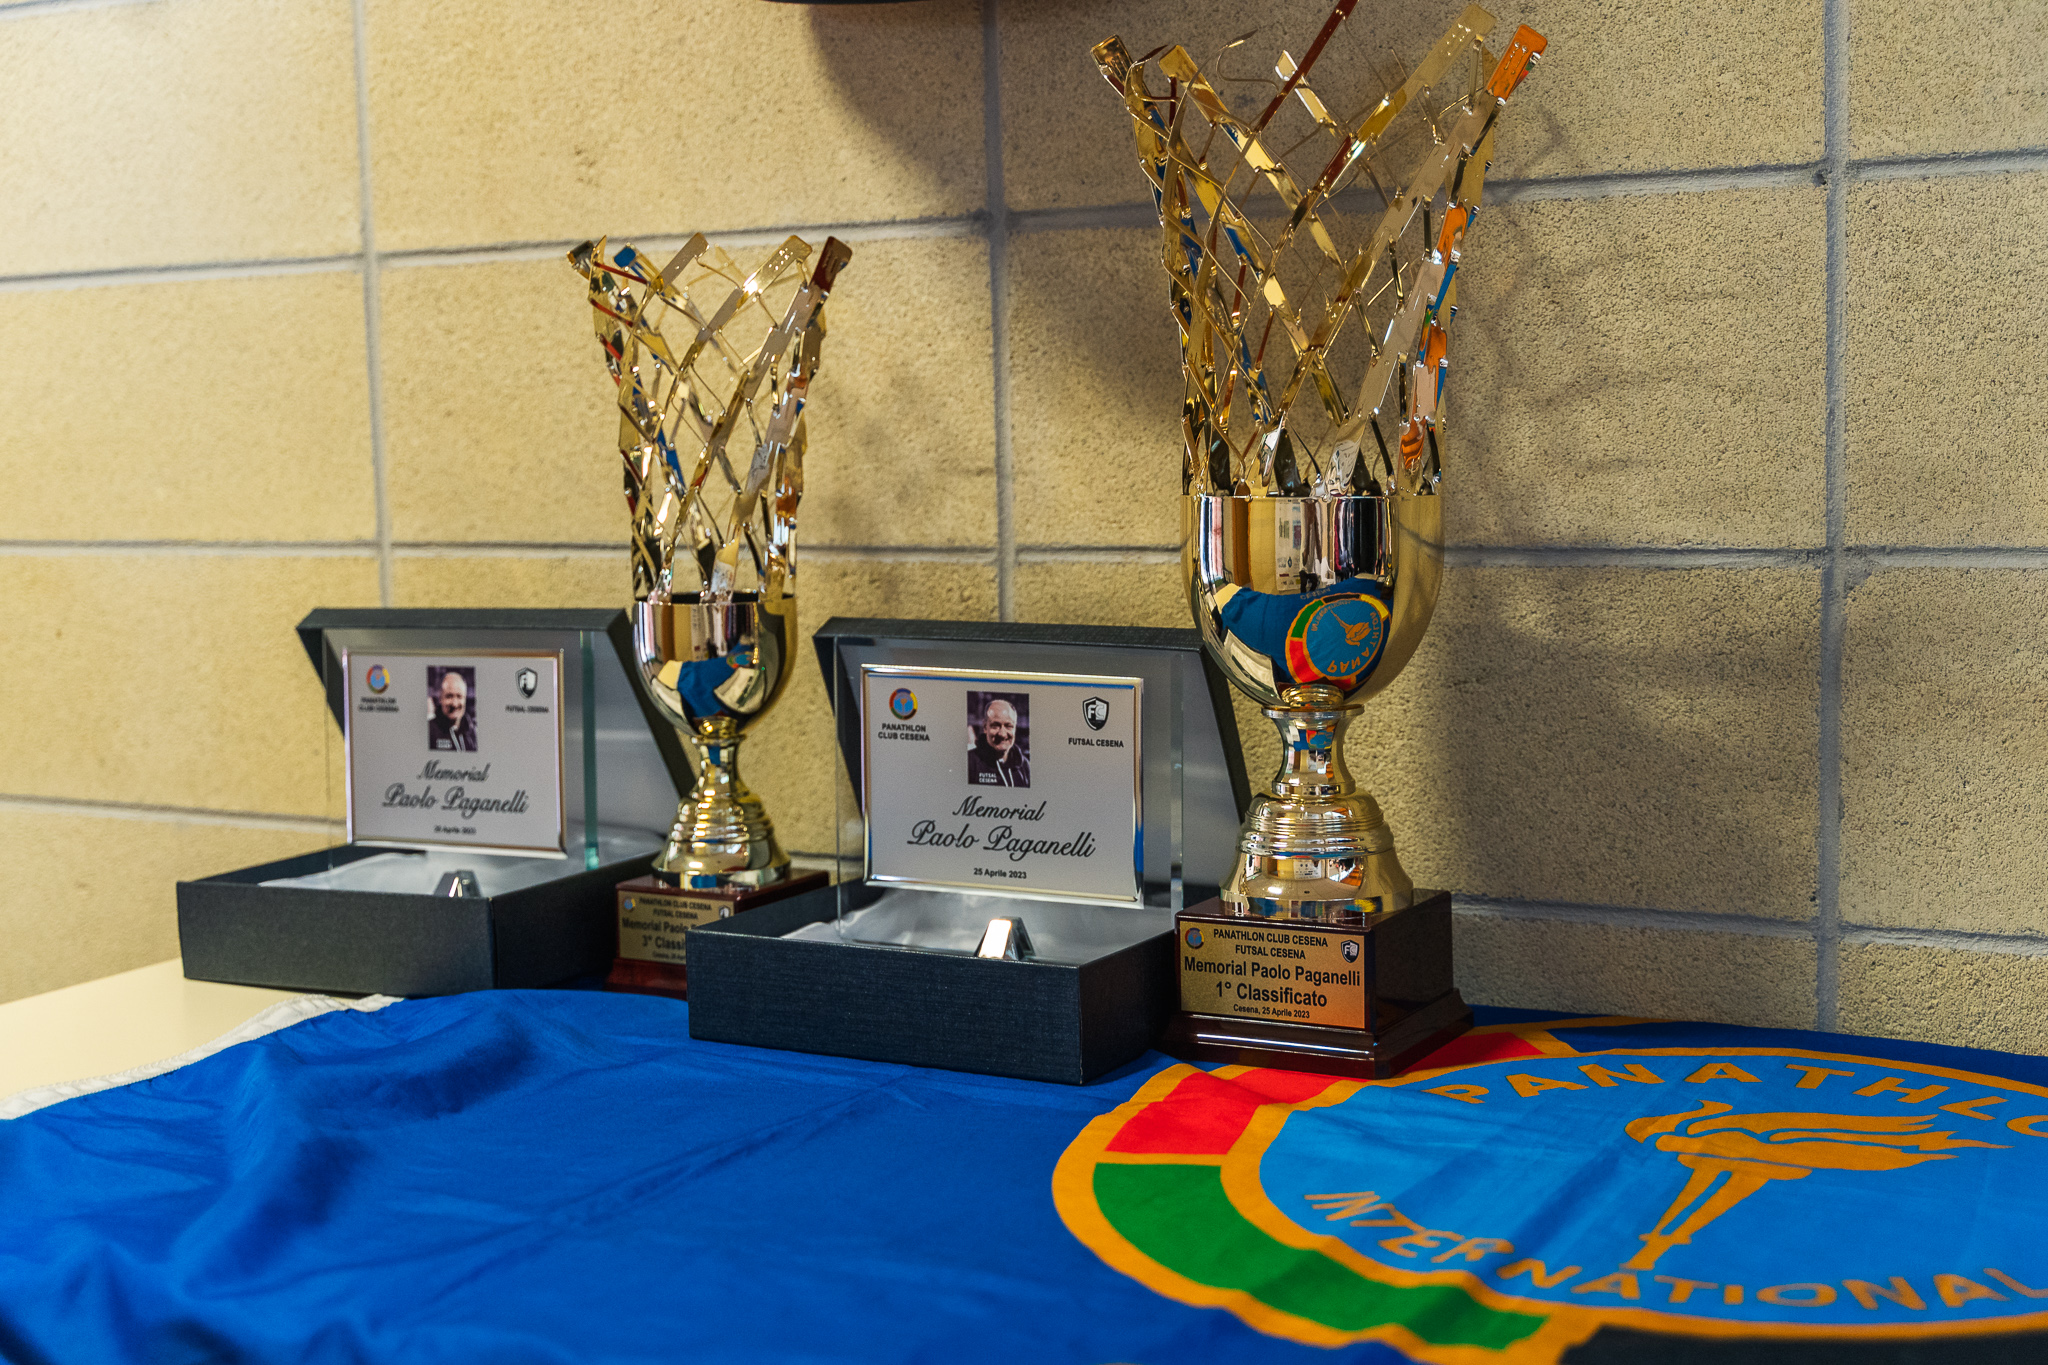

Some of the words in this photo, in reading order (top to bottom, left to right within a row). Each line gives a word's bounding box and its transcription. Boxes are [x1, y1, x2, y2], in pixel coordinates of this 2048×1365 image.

[878, 731, 898, 741] CLUB
[900, 732, 930, 742] CESENA
[881, 723, 927, 733] PANATHLON
[1068, 737, 1095, 747] FUTSAL
[1096, 738, 1124, 748] CESENA
[417, 759, 491, 782] Memorial
[382, 782, 438, 810] Paolo
[441, 786, 530, 819] Paganelli
[952, 795, 1047, 821] Memorial
[907, 820, 980, 848] Paolo
[983, 825, 1096, 861] Paganelli
[973, 868, 983, 876] 25
[984, 868, 1007, 879] Aprile
[1009, 870, 1027, 879] 2023
[1213, 928, 1264, 942] PANATHLON
[1267, 932, 1290, 944] CLUB
[1292, 935, 1328, 947] CESENA
[1235, 945, 1269, 957] FUTSAL
[1270, 947, 1306, 959] CESENA
[1184, 956, 1247, 976] Memorial
[1251, 962, 1290, 980] Paolo
[1295, 965, 1360, 987] Paganelli
[1216, 981, 1232, 997] 1°
[1237, 983, 1327, 1007] Classificato
[1233, 1003, 1261, 1015] Cesena,
[1262, 1006, 1270, 1015] 25
[1271, 1007, 1292, 1018] Aprile
[1293, 1009, 1310, 1018] 2023
[1304, 1190, 2048, 1311] INTERNATIONAL
